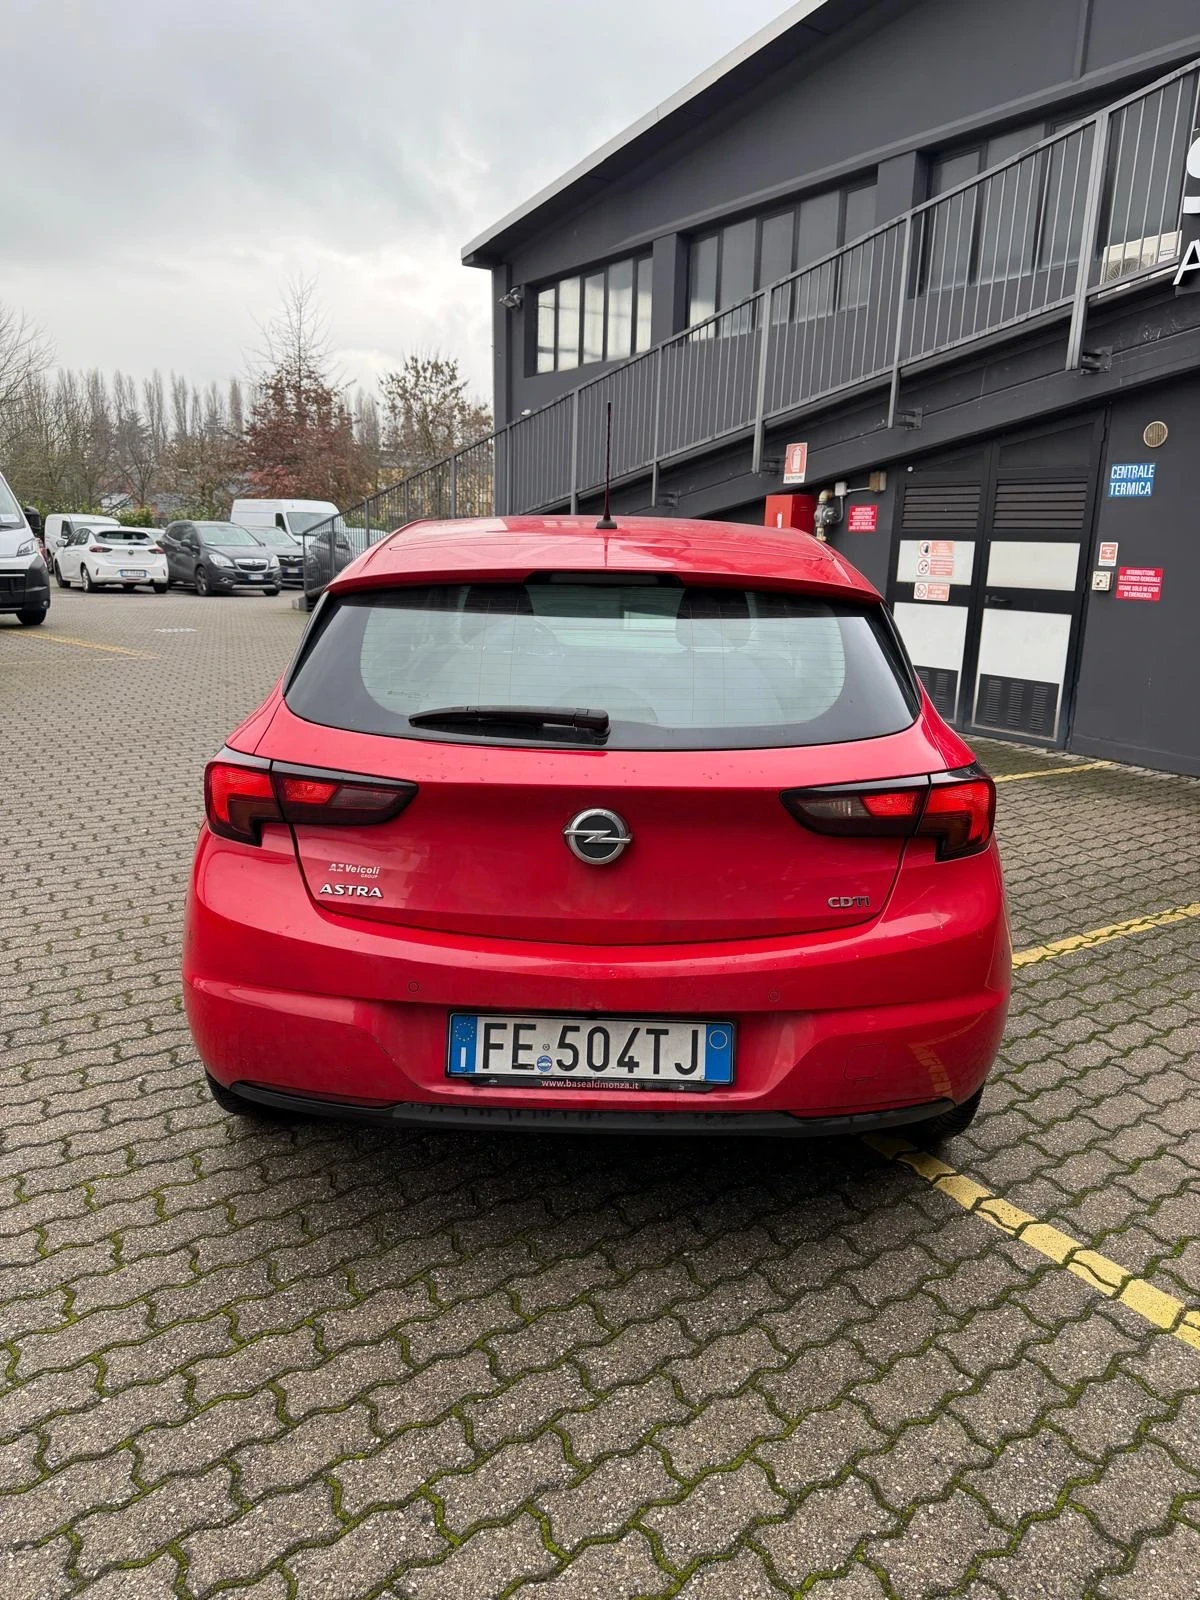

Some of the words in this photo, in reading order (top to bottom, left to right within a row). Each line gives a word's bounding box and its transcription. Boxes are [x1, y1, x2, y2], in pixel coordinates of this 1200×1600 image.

[1111, 465, 1156, 479] CENTRALE
[1109, 482, 1151, 496] TERMICA
[319, 883, 383, 898] ASTRA
[827, 895, 870, 908] CDTI
